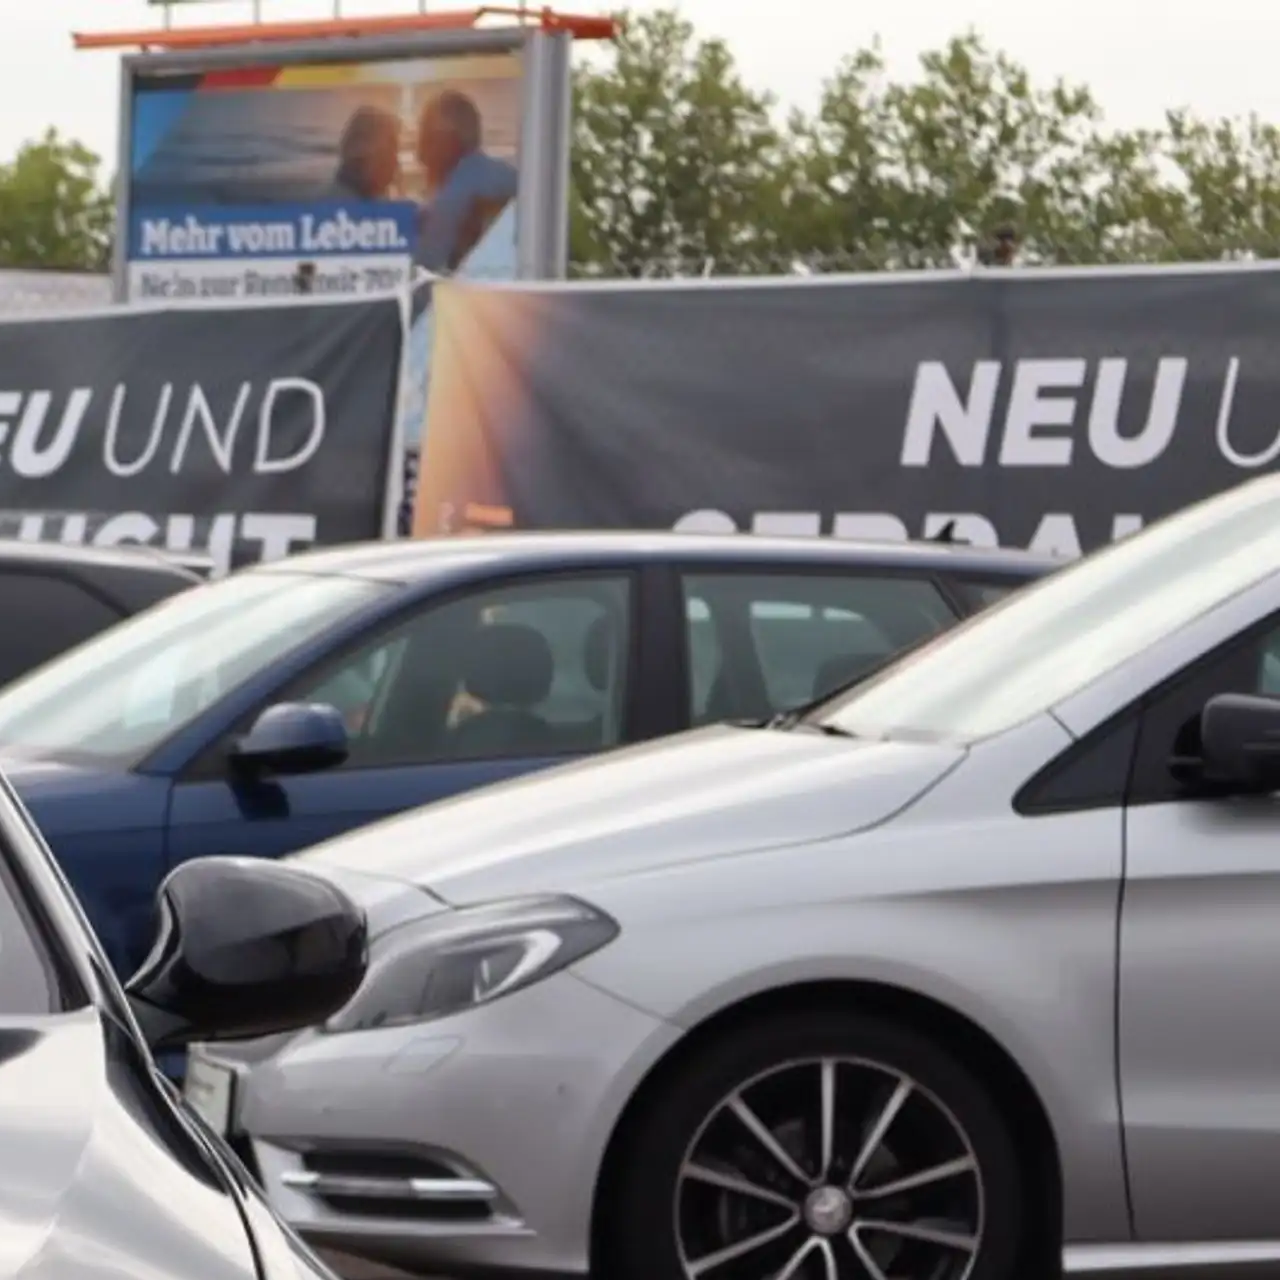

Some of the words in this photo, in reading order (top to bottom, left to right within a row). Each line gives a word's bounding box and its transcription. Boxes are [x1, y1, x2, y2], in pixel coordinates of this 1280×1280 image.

[142, 213, 223, 255] Mehr
[227, 221, 294, 251] vom
[299, 208, 407, 249] Leben.
[103, 377, 325, 477] UND
[900, 357, 1188, 467] NEU
